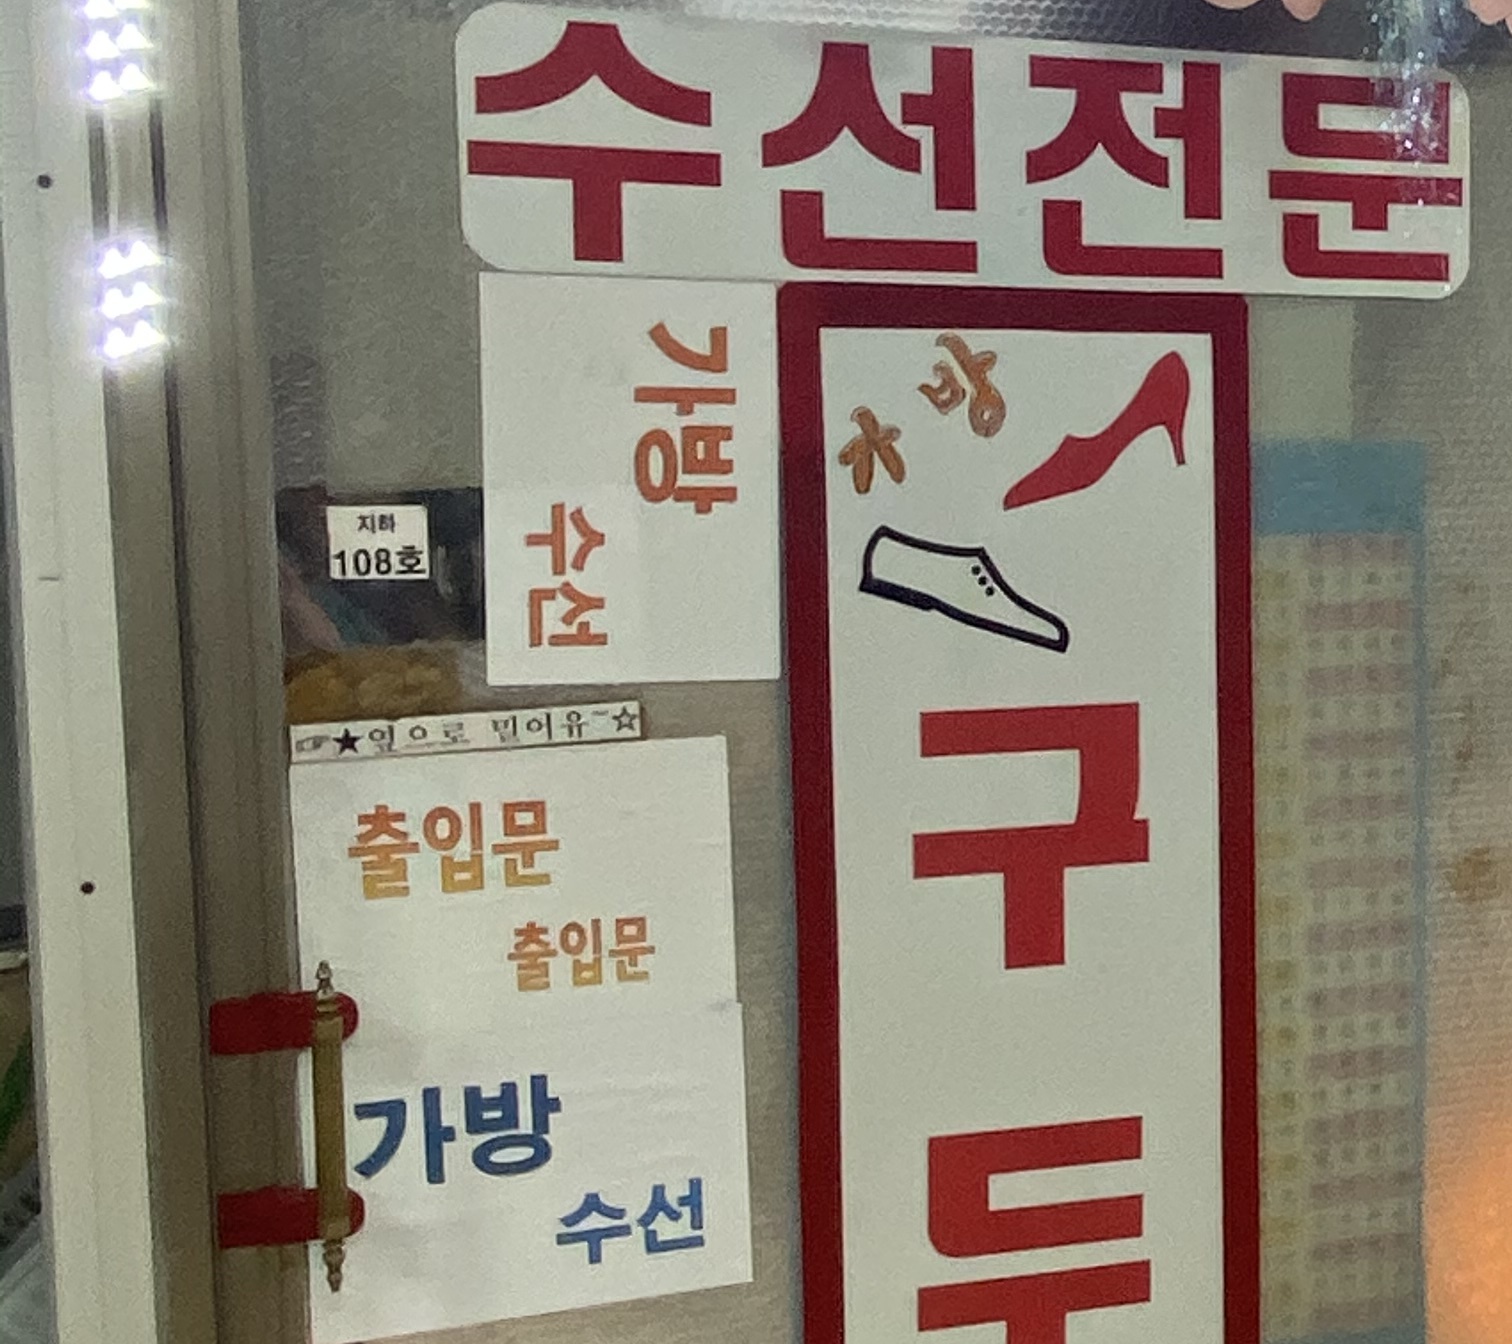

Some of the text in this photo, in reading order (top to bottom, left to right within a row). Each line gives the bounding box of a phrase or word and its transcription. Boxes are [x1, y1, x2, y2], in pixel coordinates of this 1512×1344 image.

[467, 20, 1463, 282] 수선전문
[634, 322, 738, 514] 가방
[838, 331, 1007, 495] 가방
[333, 545, 426, 577] 108호
[356, 513, 396, 534] 지하
[526, 502, 608, 648] 수선
[347, 800, 561, 900] 출입문
[507, 916, 656, 993] 출입문
[354, 1073, 562, 1185] 가방
[556, 1177, 705, 1265] 수선
